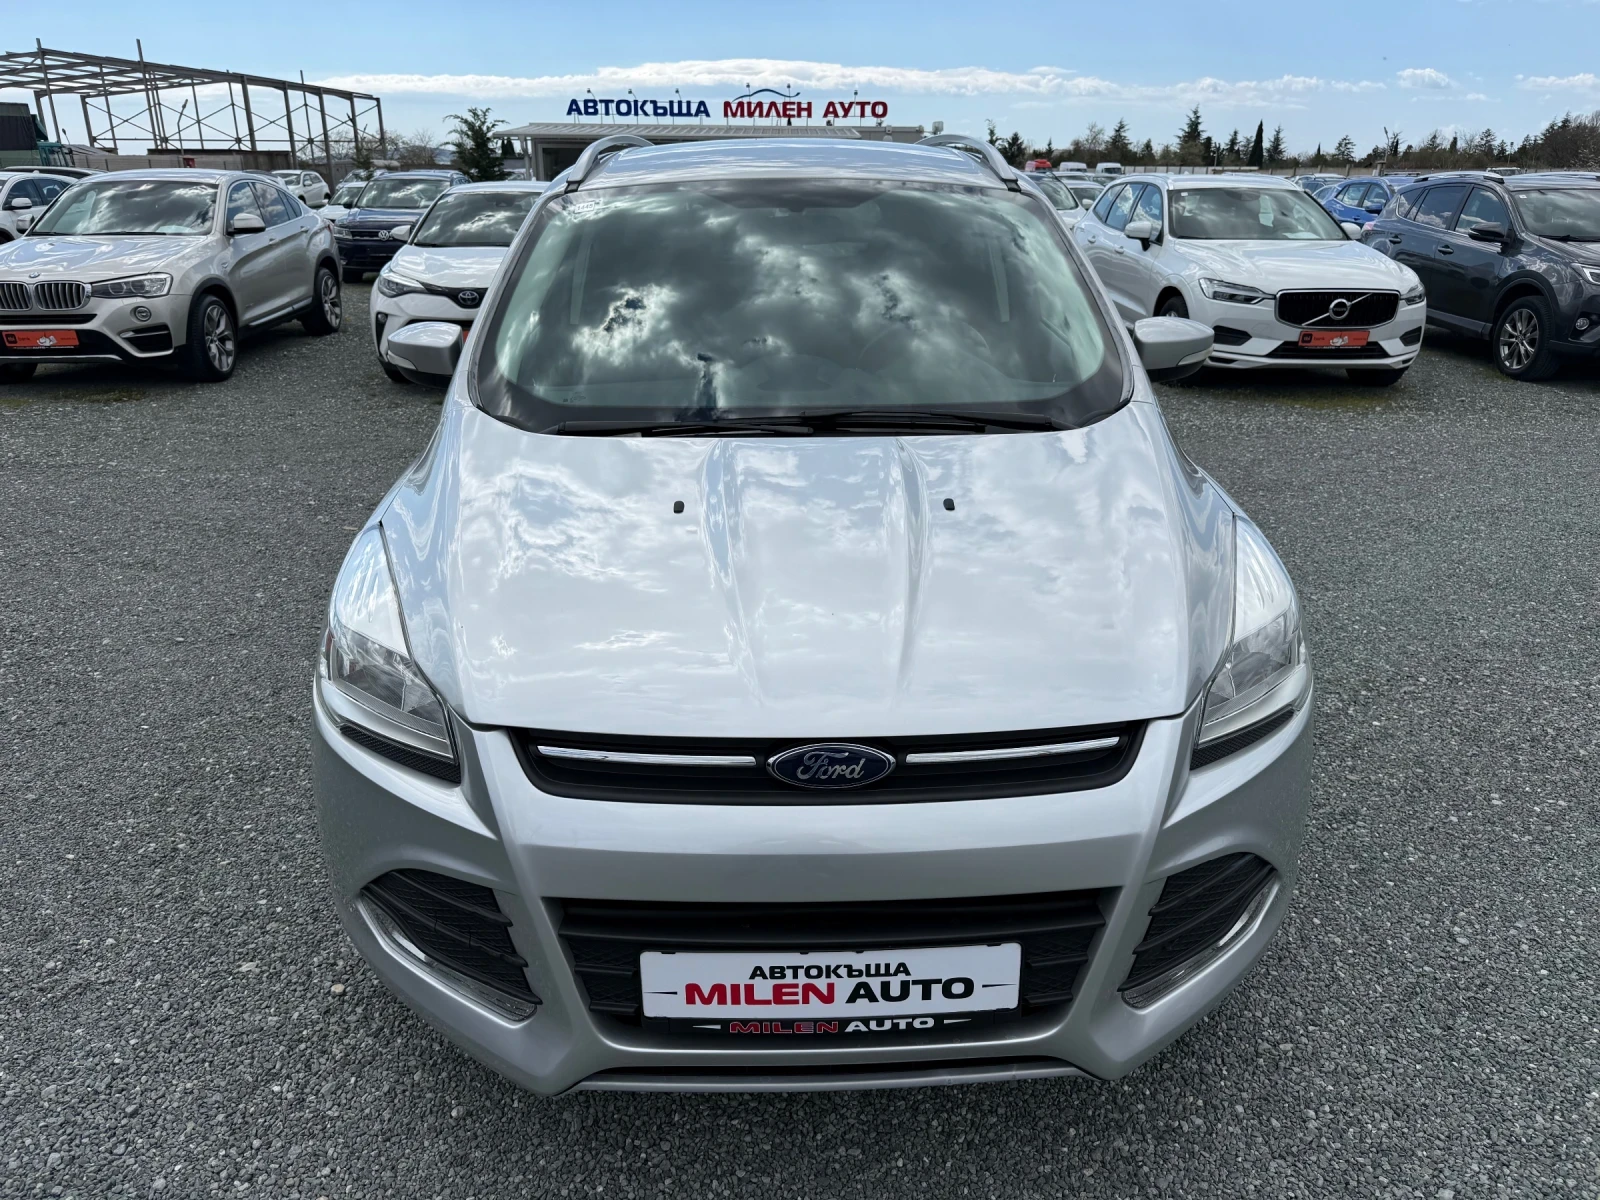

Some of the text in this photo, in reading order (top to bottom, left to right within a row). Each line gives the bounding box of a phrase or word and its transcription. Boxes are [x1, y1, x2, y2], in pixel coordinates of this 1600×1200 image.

[566, 98, 888, 118] АВТОКЪЩА МИЛЕН АУТО
[796, 751, 865, 780] Ford
[748, 962, 911, 980] АВТОКЪЩА
[684, 976, 974, 1006] MILEN AUTO
[729, 1017, 934, 1034] MILEN AUTO
